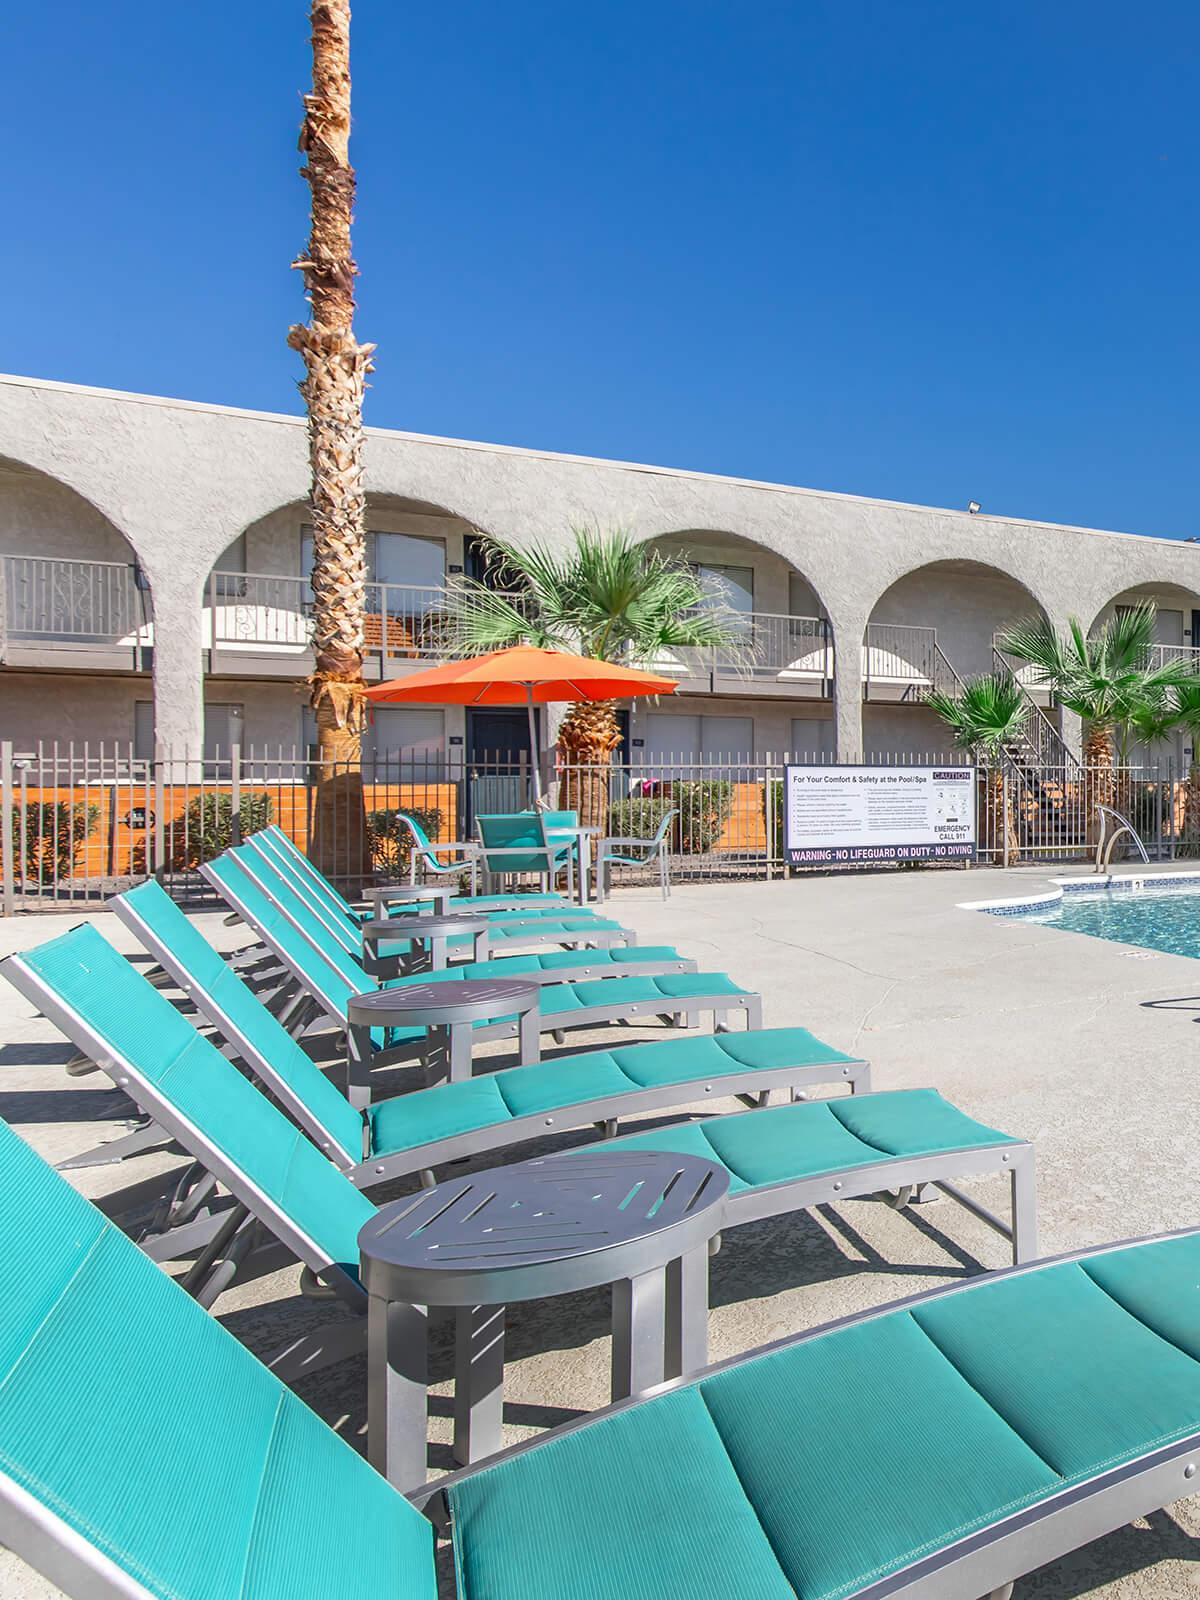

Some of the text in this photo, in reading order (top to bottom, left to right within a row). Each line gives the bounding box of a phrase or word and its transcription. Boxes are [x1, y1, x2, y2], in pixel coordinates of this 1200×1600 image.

[859, 776, 878, 785] Safety
[899, 776, 927, 785] Pool/Spa
[934, 825, 970, 833] EMERGENCY
[850, 848, 896, 859] LIFEGUARD
[897, 847, 909, 857] ON
[948, 845, 972, 855] DIVING
